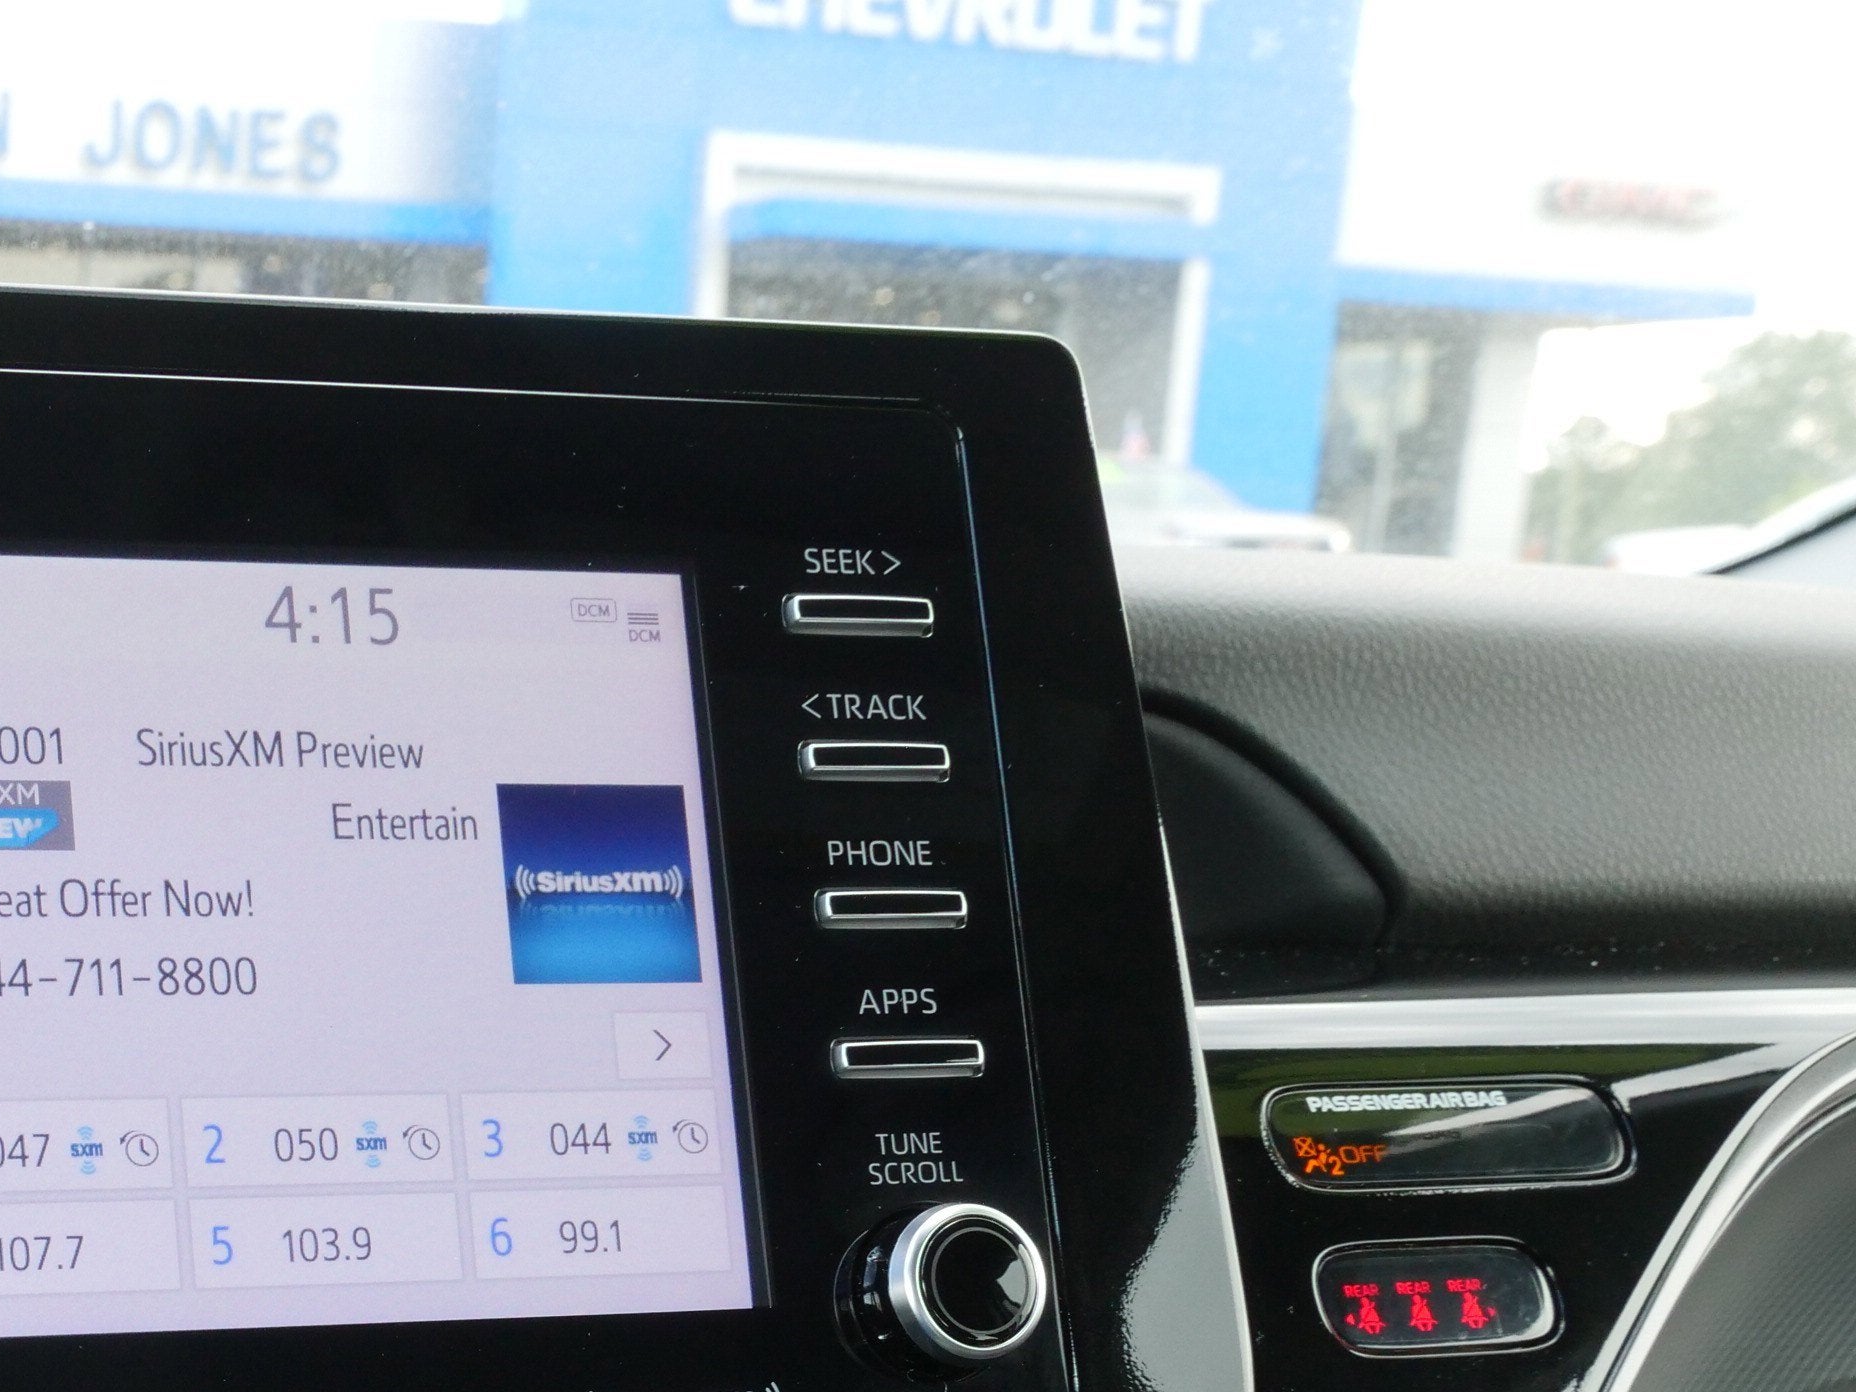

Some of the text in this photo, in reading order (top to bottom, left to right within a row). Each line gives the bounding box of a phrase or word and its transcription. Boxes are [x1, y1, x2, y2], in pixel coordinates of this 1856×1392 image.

[82, 98, 340, 184] JONES
[264, 585, 400, 647] 4:15
[577, 602, 611, 619] DCM
[628, 629, 662, 644] DCM
[136, 727, 424, 770] SiriusXM Preview
[332, 802, 479, 842] Entertain
[827, 840, 933, 866] PHONE
[60, 878, 151, 918] Offer
[163, 879, 254, 918] Now!
[859, 988, 937, 1015] APPS
[1305, 1092, 1429, 1112] PASSENGER
[202, 1123, 226, 1164] 2
[274, 1127, 339, 1163] 050
[481, 1118, 504, 1158] 3
[549, 1121, 612, 1157] 044
[875, 1132, 943, 1155] TUNE
[1338, 1144, 1388, 1164] OFF
[868, 1160, 963, 1186] SCROLL
[212, 1225, 372, 1266] 5 103.9
[490, 1217, 622, 1258] 6 99.1
[1343, 1283, 1379, 1297] REAR
[1395, 1281, 1431, 1295] REAR
[1446, 1278, 1482, 1292] REAR
